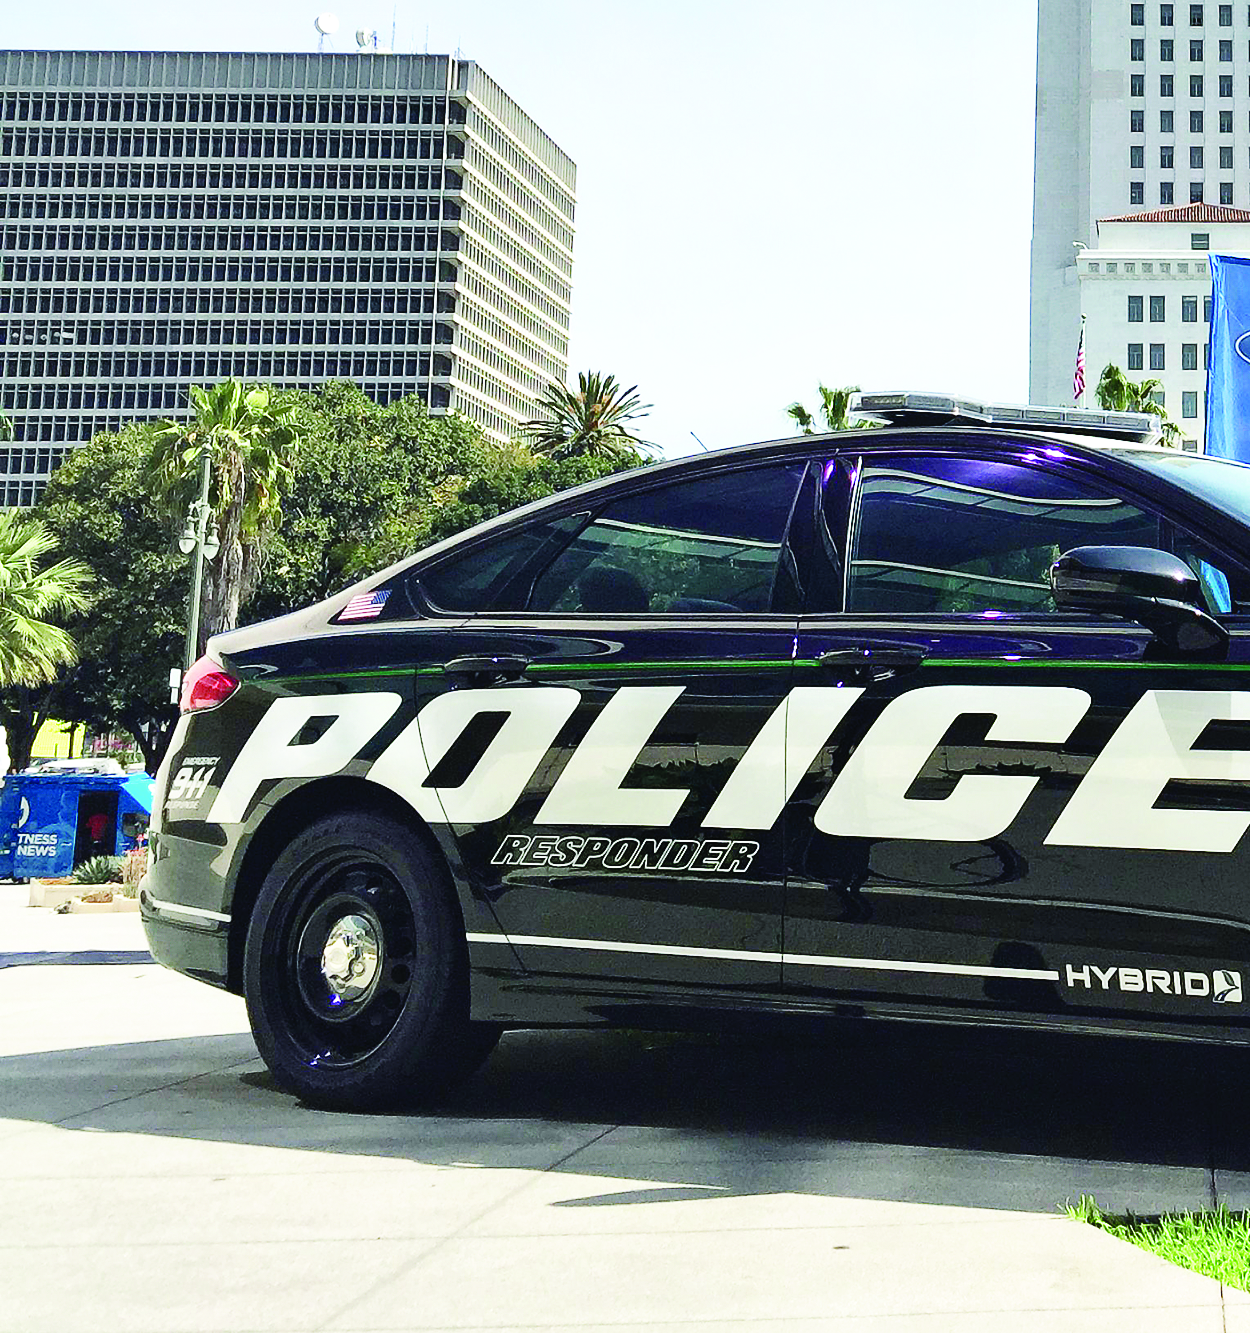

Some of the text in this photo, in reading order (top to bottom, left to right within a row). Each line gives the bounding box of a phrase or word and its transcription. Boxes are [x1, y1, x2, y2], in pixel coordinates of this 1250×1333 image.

[17, 845, 57, 857] NEWS
[490, 835, 760, 873] RESPONDER
[1065, 963, 1210, 997] HYBRID
